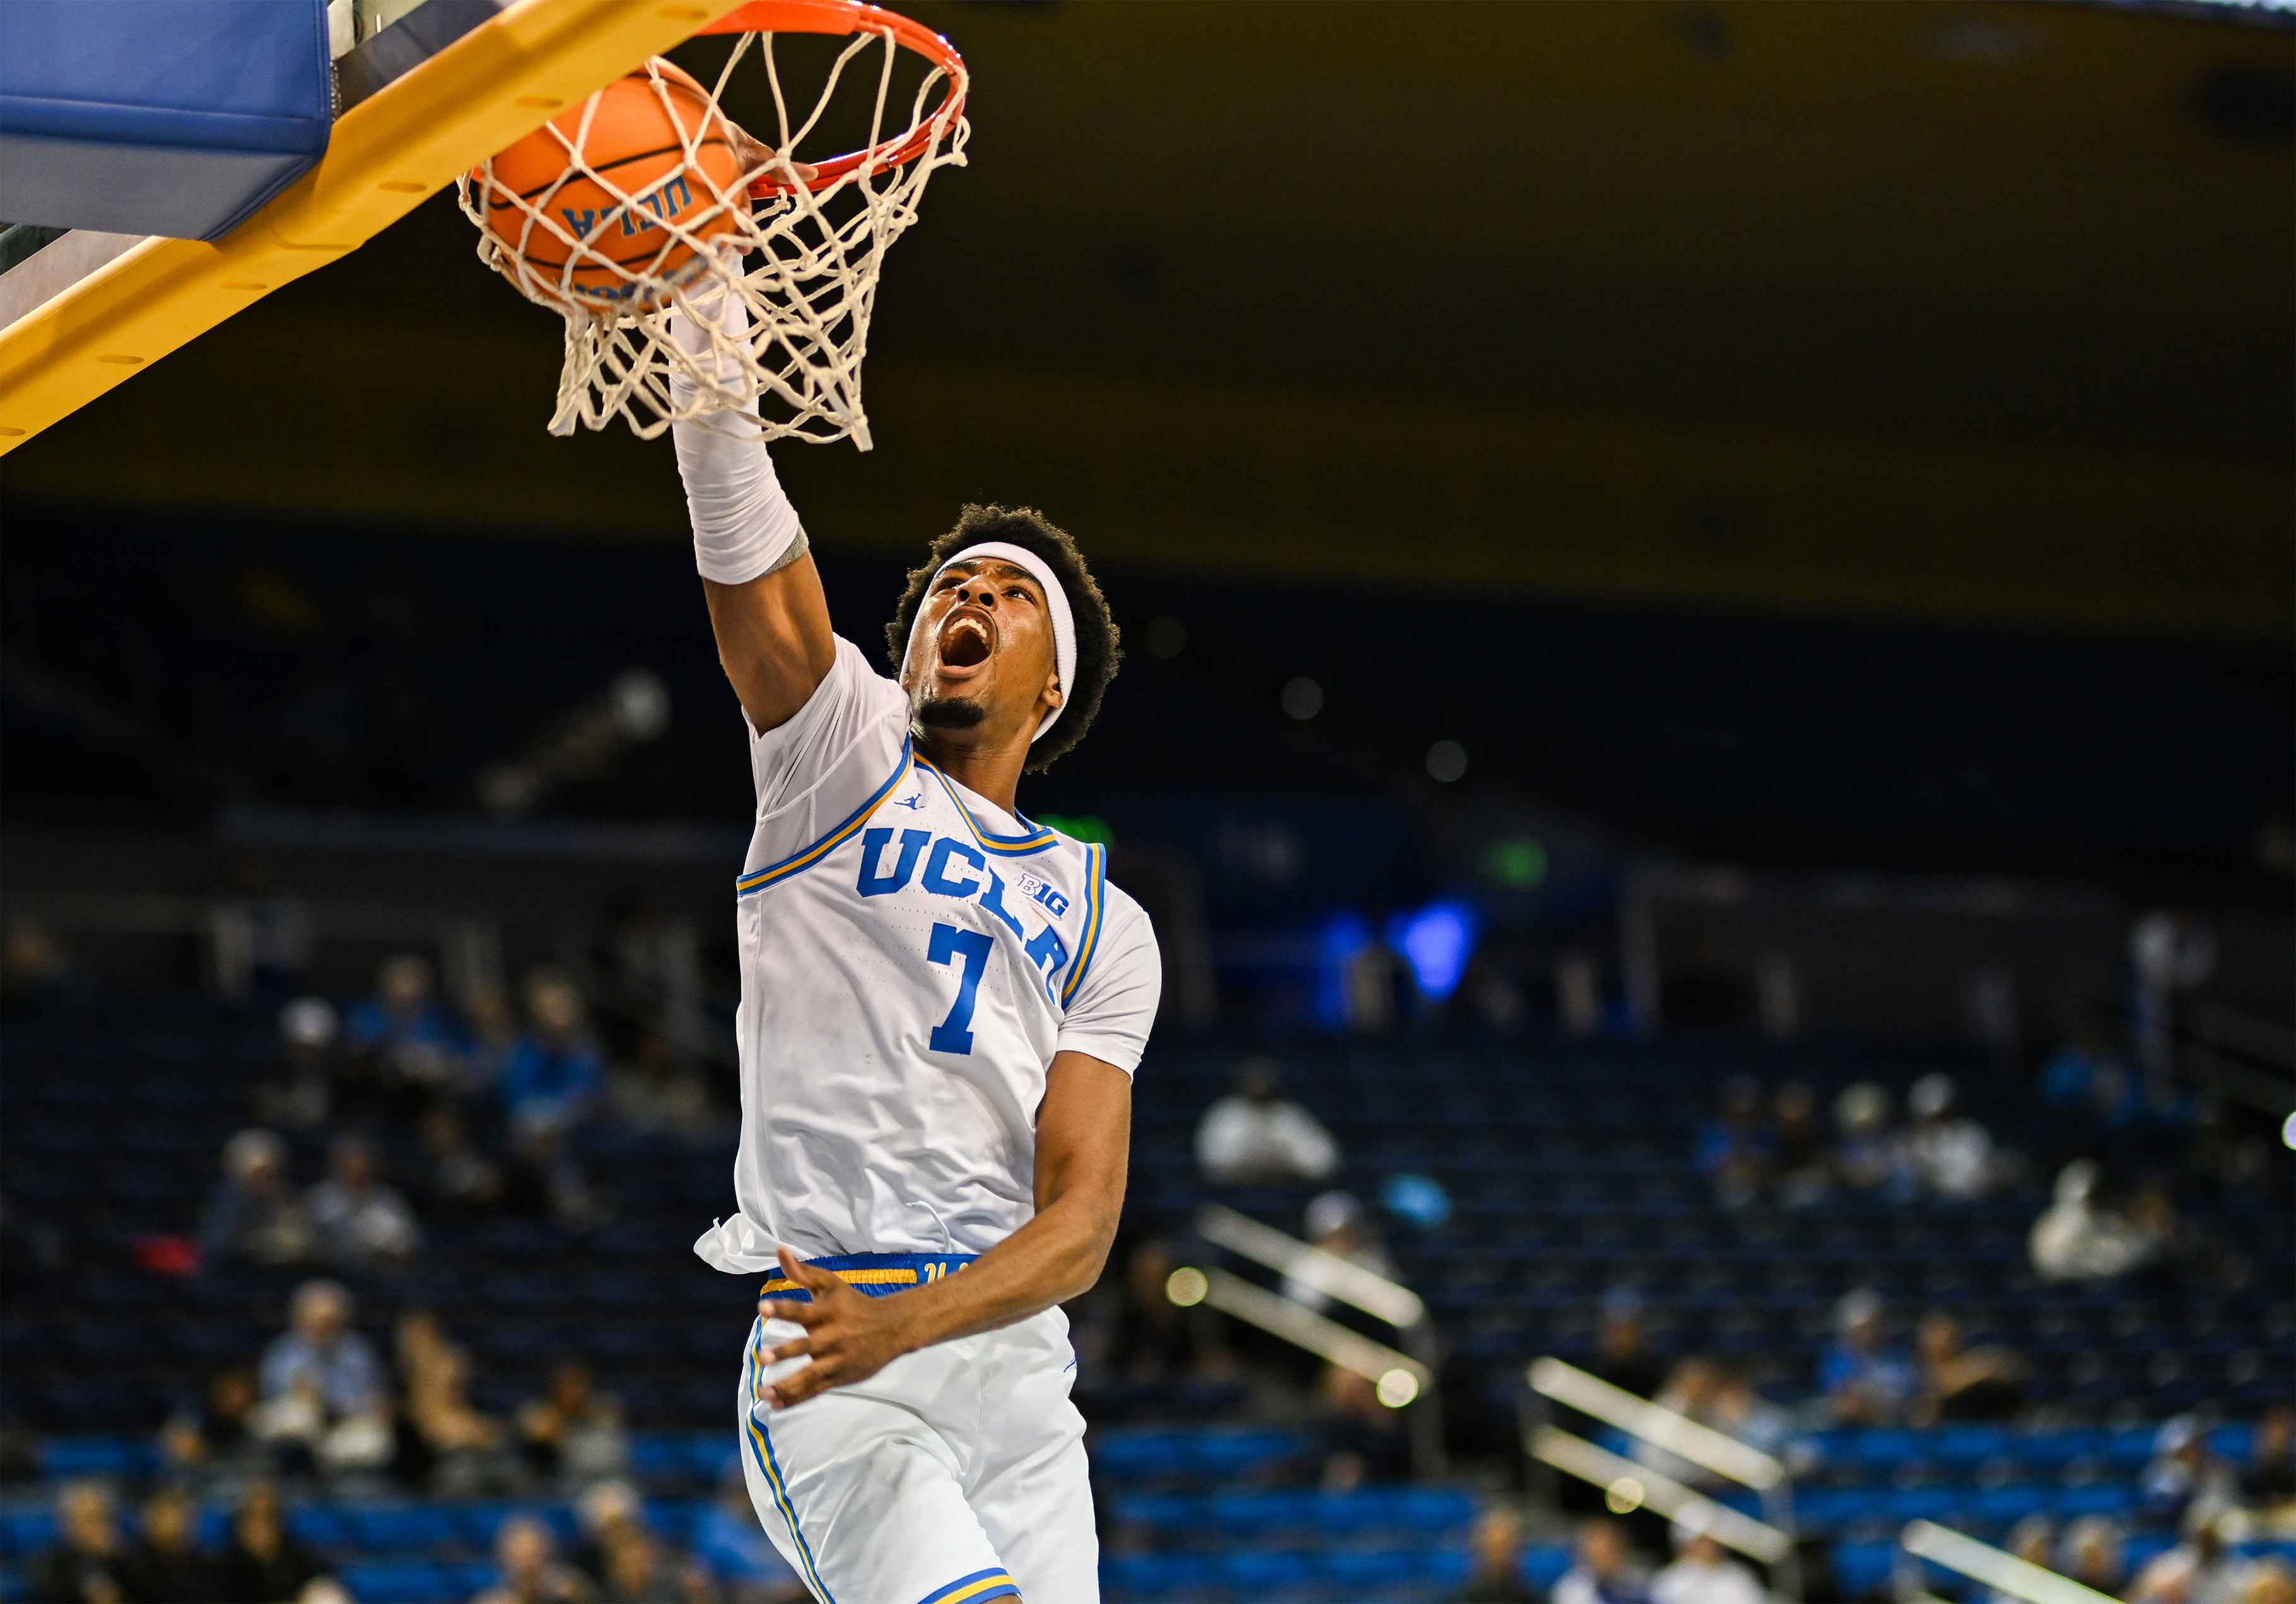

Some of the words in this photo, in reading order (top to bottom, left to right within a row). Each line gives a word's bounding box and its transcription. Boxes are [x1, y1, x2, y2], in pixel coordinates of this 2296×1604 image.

[561, 175, 692, 240] UCLA
[856, 827, 1068, 1006] UCLA
[927, 922, 994, 1055] 7
